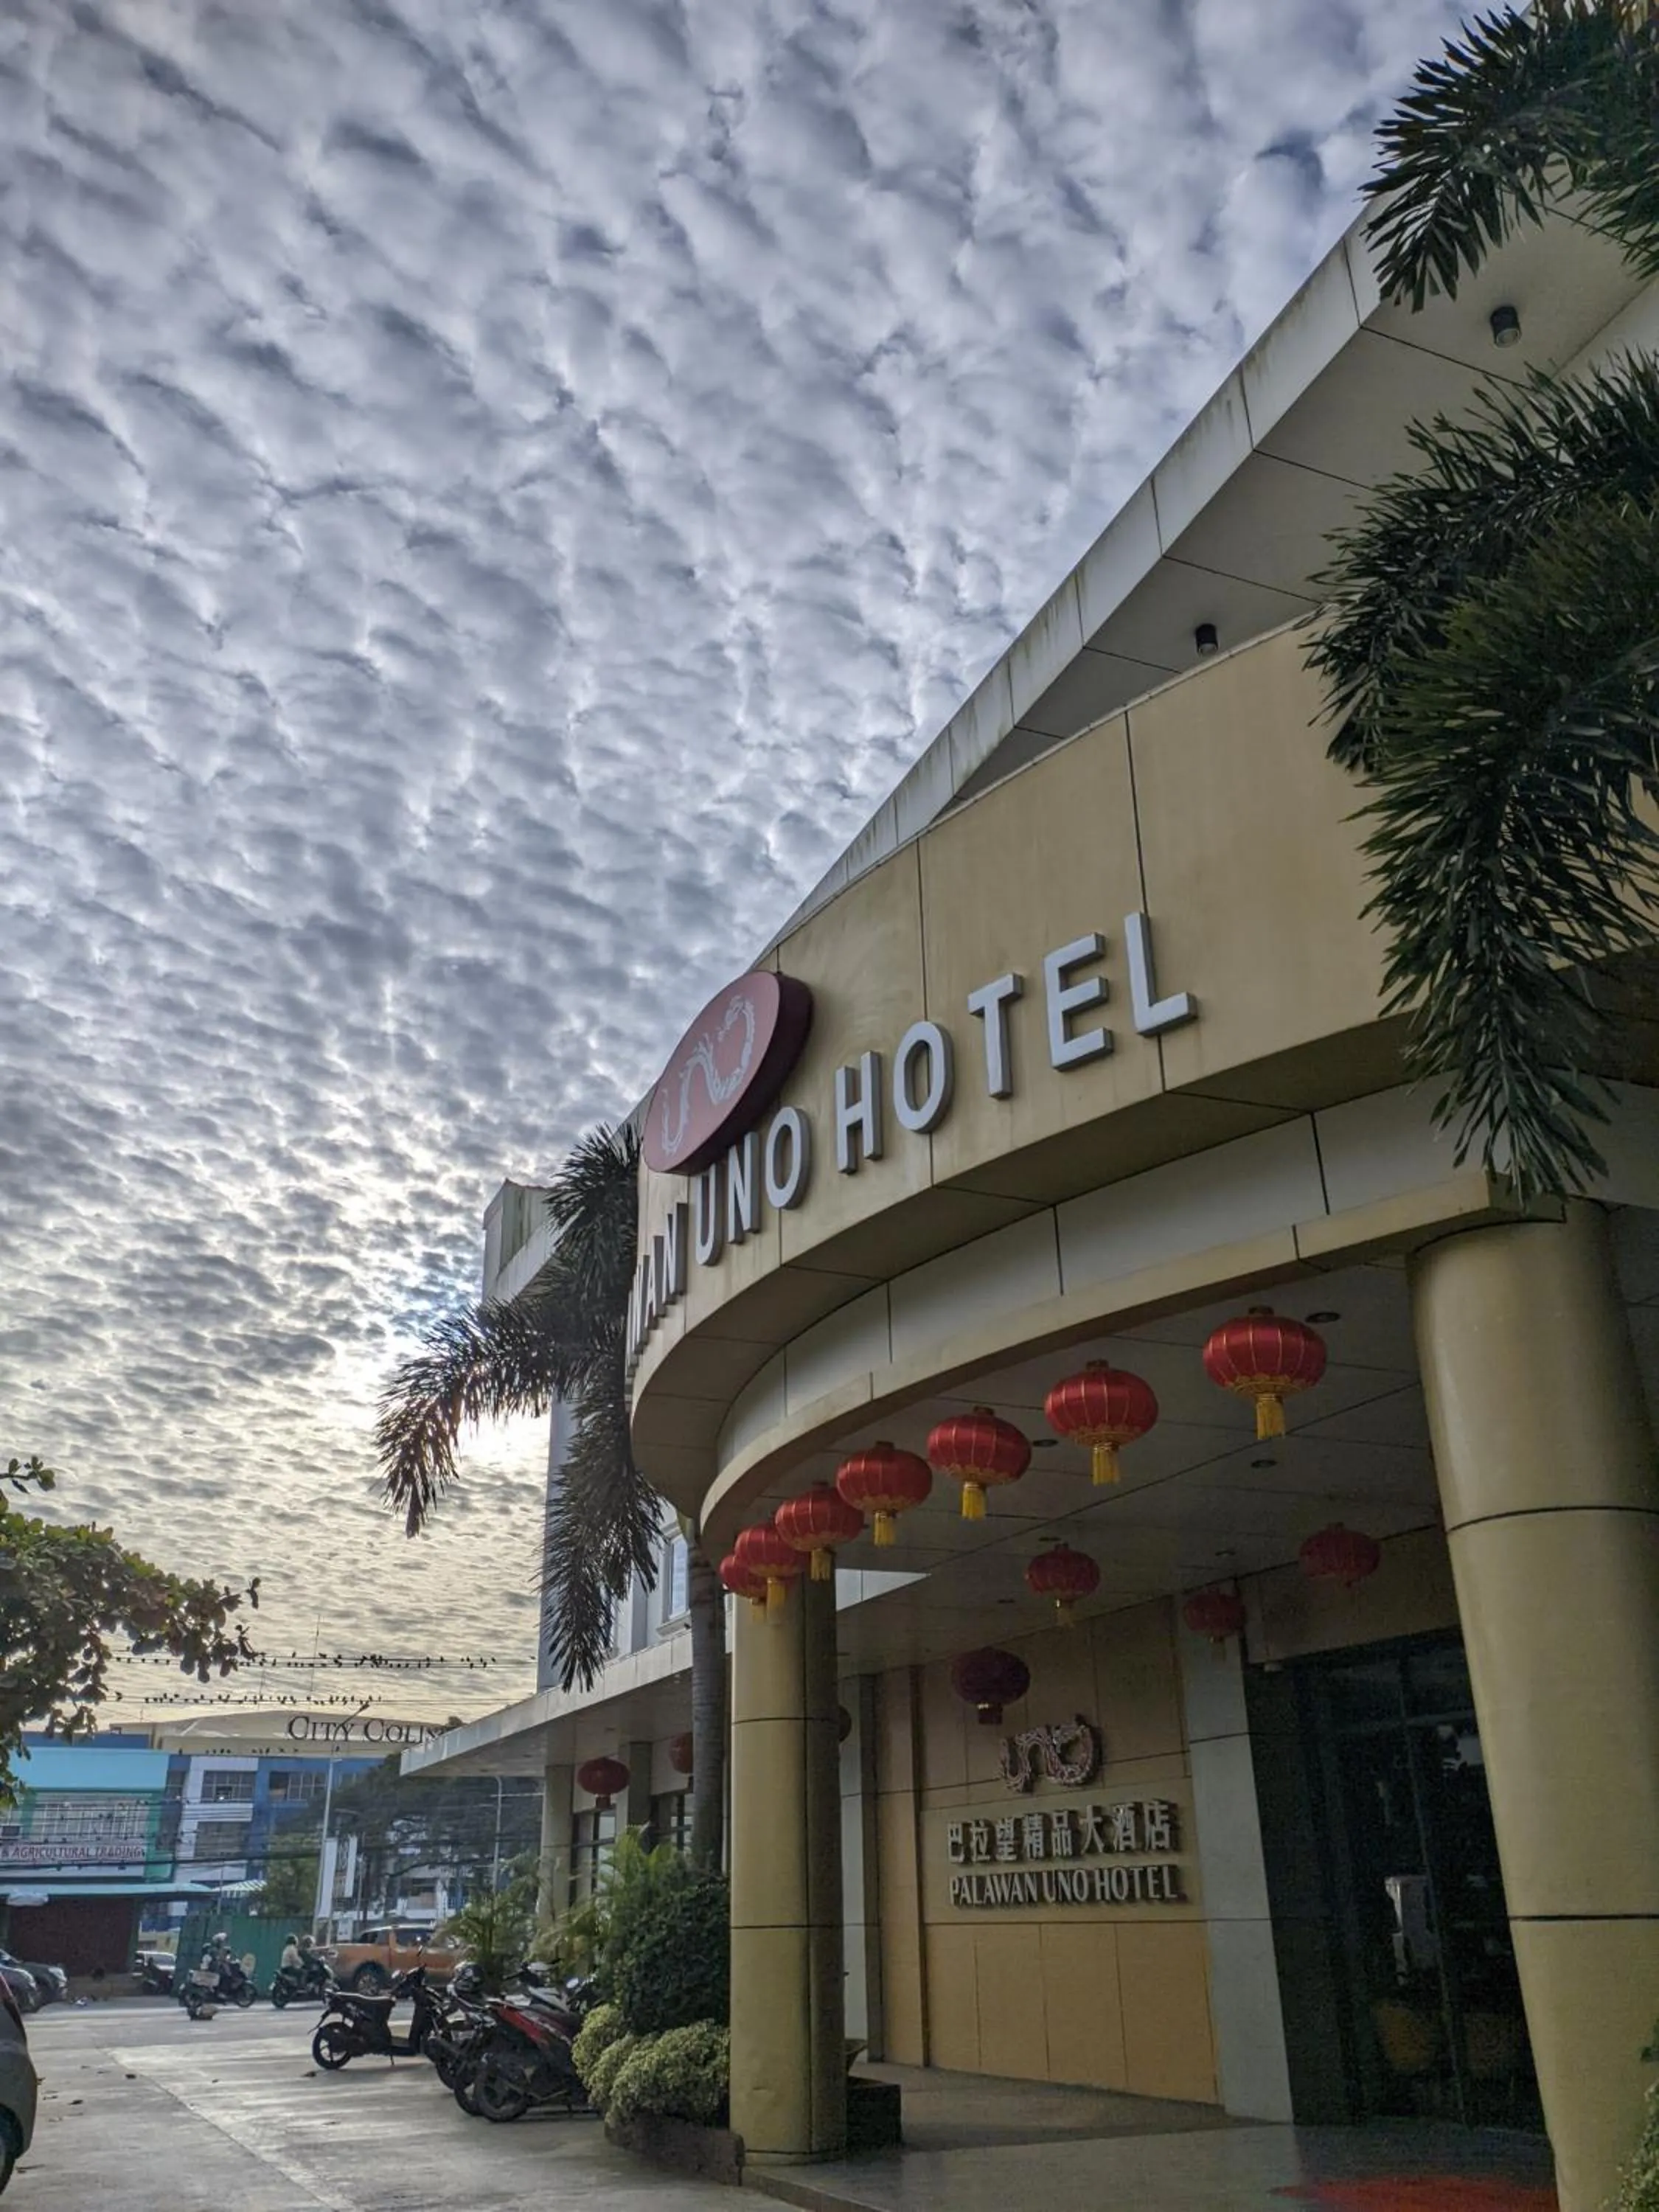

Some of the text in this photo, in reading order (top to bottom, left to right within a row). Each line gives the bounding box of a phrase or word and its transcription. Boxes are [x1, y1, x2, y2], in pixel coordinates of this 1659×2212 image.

[695, 1106, 810, 1267] UNO
[835, 911, 1200, 1175] HOTEL
[13, 1846, 92, 1859] AGRICULTURAL
[97, 1846, 142, 1858] TRADING
[950, 1865, 1178, 1905] PALAWAN UNO HOTEL
